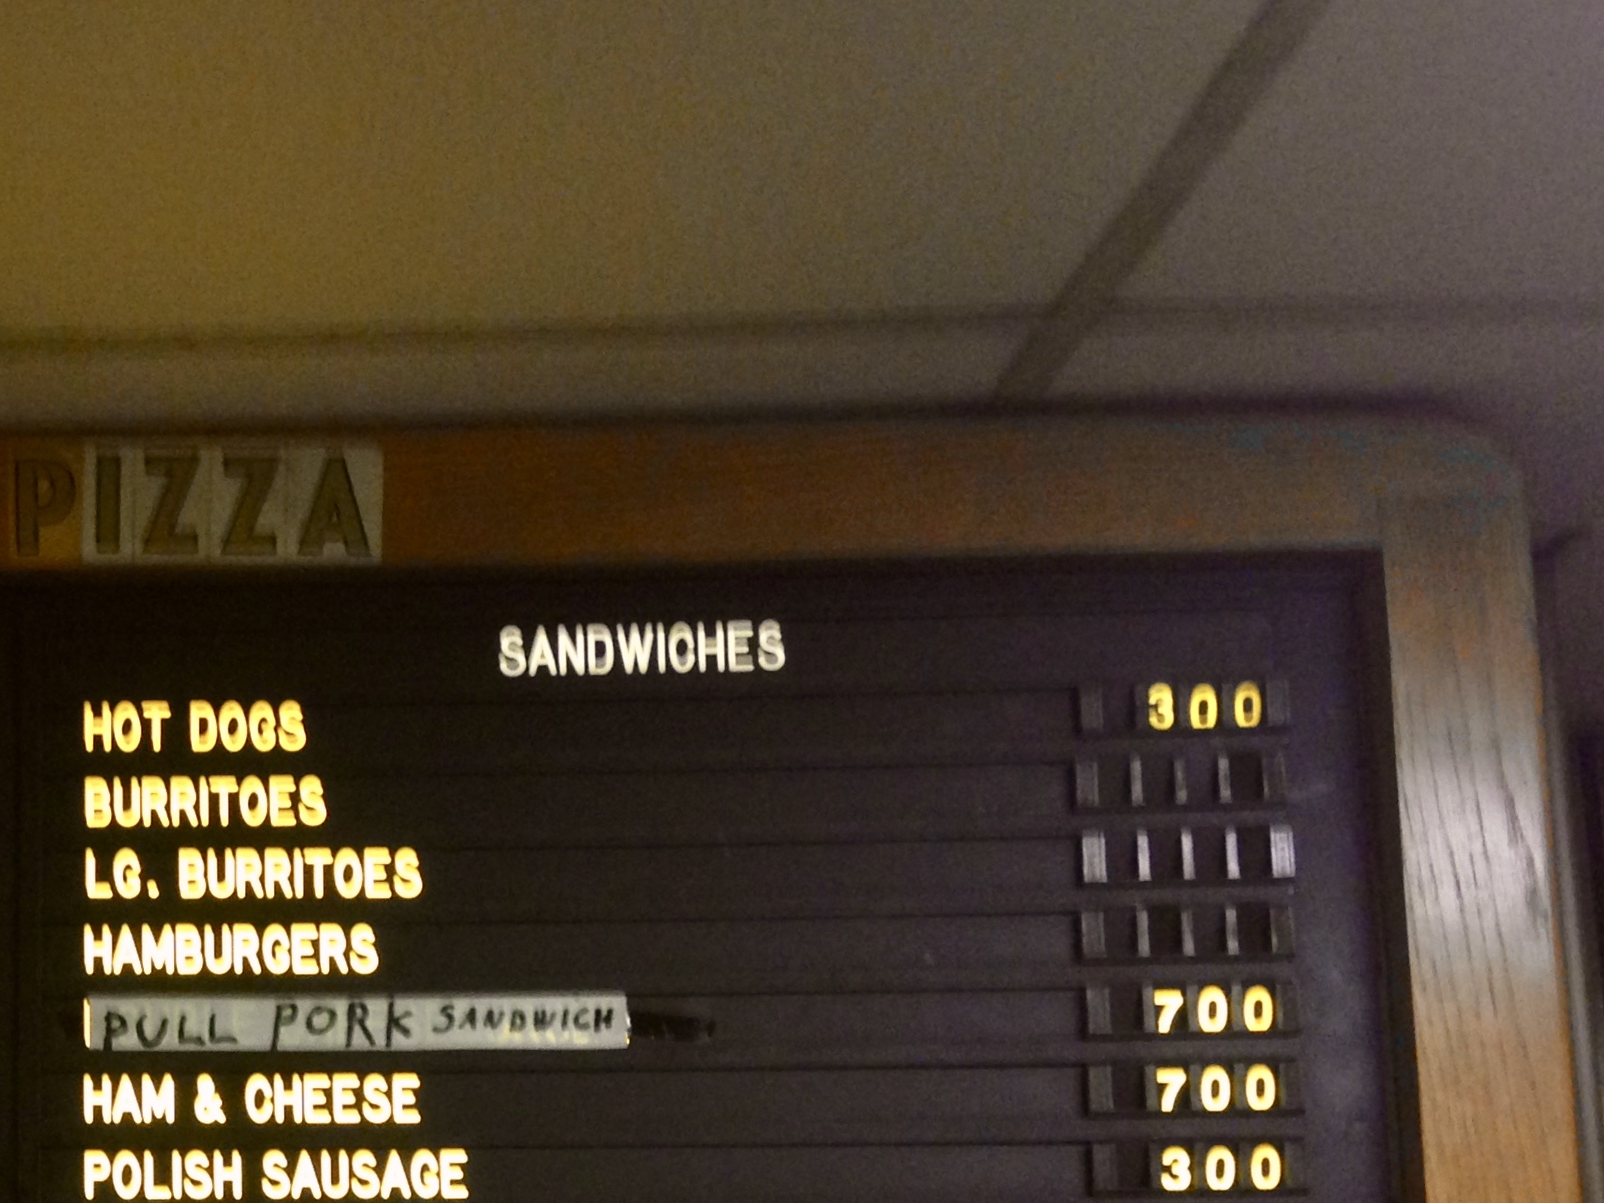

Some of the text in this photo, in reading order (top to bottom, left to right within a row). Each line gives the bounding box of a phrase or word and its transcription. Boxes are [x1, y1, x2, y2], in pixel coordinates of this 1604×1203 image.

[13, 452, 373, 558] PIZZA
[498, 619, 785, 677] SANDWICHES
[84, 680, 1262, 752] HOT DOGS 300
[84, 774, 327, 828] BURRITOES
[85, 847, 422, 899] LG. BURRITOES
[84, 922, 379, 975] HAMBURGERS
[102, 995, 615, 1052] PULL PORK SANDWICH
[1153, 985, 1273, 1034] 700
[83, 1064, 1276, 1125] HAM & CHEESE 700
[83, 1143, 1282, 1200] POLISH SAUSAGE 300
